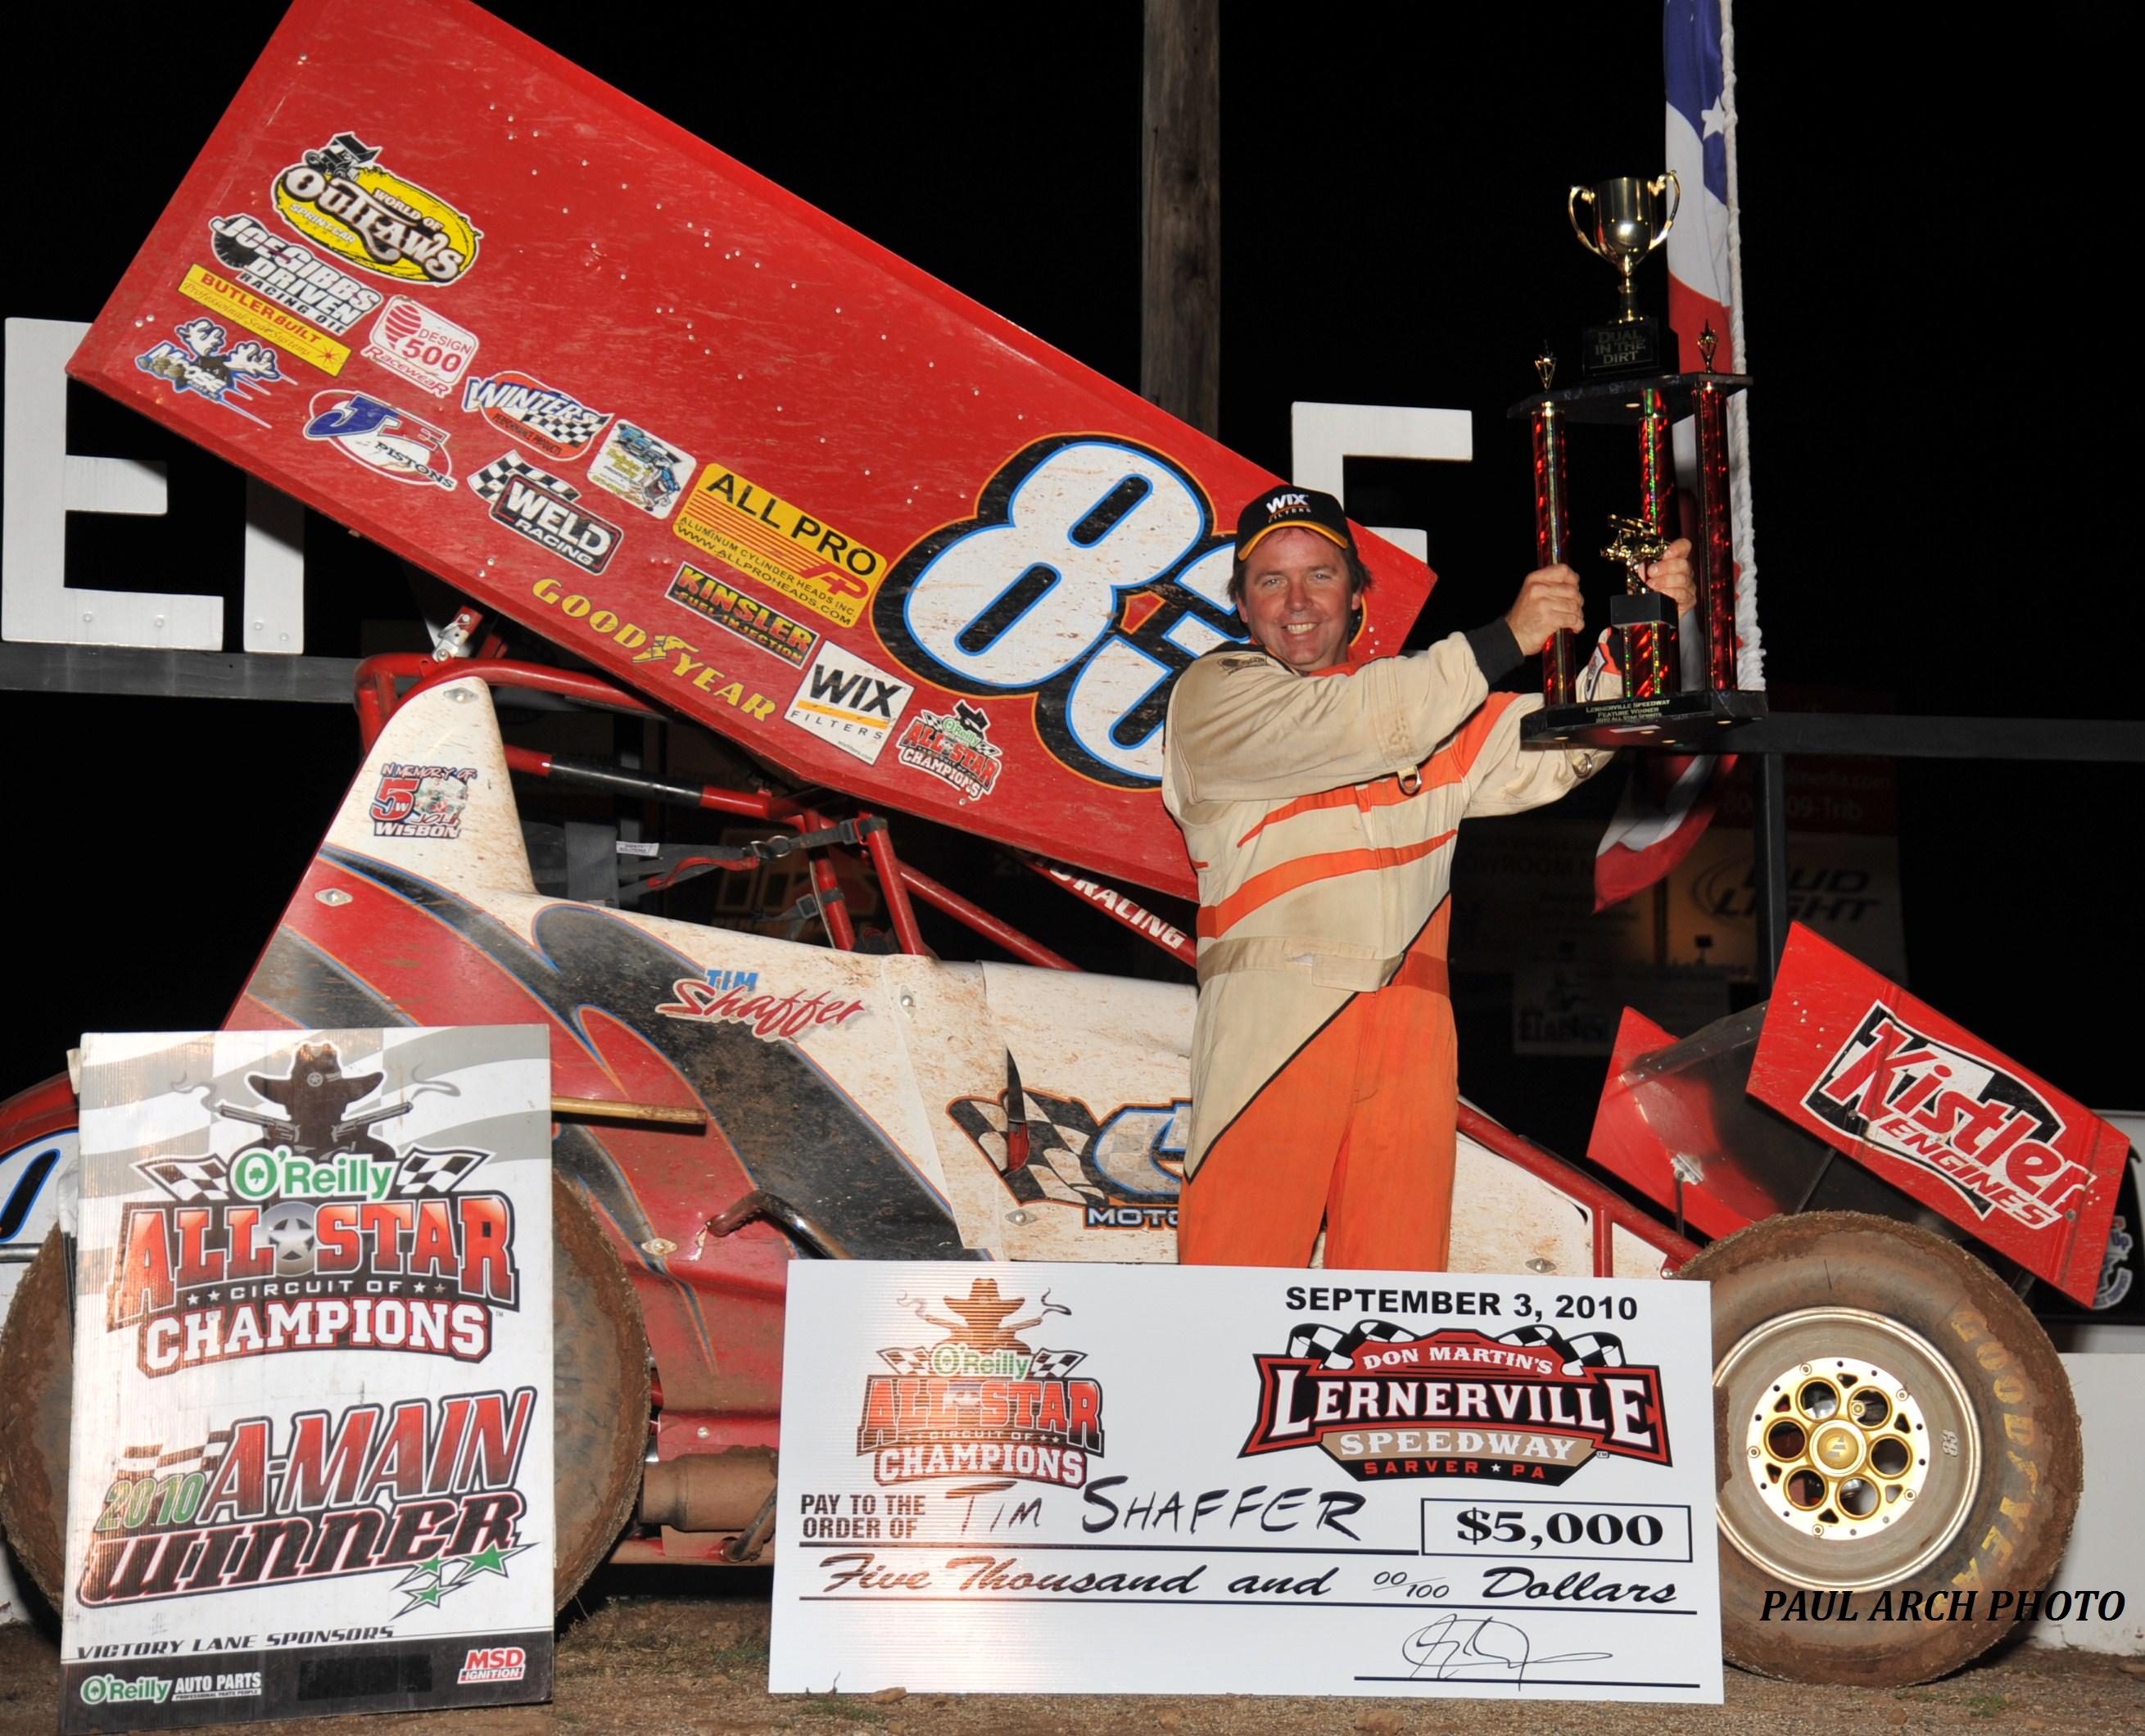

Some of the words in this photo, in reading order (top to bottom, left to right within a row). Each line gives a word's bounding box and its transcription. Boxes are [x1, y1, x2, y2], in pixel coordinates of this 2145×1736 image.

[289, 203, 332, 232] SPRINT
[330, 224, 356, 243] CAR
[372, 188, 423, 219] WORLD
[421, 216, 445, 232] OF
[238, 273, 310, 315] RACING
[247, 256, 364, 327] DRIVEN
[402, 337, 462, 373] 500
[419, 328, 473, 355] DESIGN
[1603, 350, 1639, 365] DIRT
[464, 377, 600, 425] WINTERS
[374, 441, 455, 489] PISTONS
[505, 481, 613, 556] WELD
[706, 472, 781, 530] ALL
[790, 515, 877, 576] PRO
[1266, 494, 1308, 513] WIX
[514, 518, 594, 567] RACING
[677, 526, 851, 626] WWW.ALLPROHEADS.COM
[680, 516, 739, 552] ALUMINUM
[740, 549, 795, 584] CYLINDER
[796, 579, 835, 605] HEADS
[835, 600, 856, 618] INC.
[677, 566, 813, 651] KINSLER
[678, 589, 716, 617] FUEL
[721, 613, 803, 663] INJECTION
[809, 663, 903, 718] WIX
[1632, 698, 1672, 709] SPEEDWAY
[790, 710, 884, 741] FILTERS
[1597, 709, 1629, 719] FEATURE
[1630, 707, 1660, 717] WINNER
[396, 765, 456, 780] MEMORY
[900, 721, 944, 755] ALL
[948, 743, 999, 789] STAR
[902, 748, 982, 798] CHAMPIONS
[1073, 878, 1188, 950] RACING
[706, 969, 759, 993] TIM
[658, 979, 865, 1040] Shaffer
[1821, 1018, 2097, 1206] Kistler
[235, 1149, 392, 1198] O'Reilly
[1878, 1113, 2063, 1229] ENGINES
[112, 1201, 278, 1322] ALL
[313, 1194, 518, 1304] STAR
[230, 1280, 354, 1300] CIRCUIT
[366, 1280, 403, 1295] OF
[1285, 1286, 1501, 1316] SEPTEMBER
[1514, 1293, 1543, 1322] 3,
[1555, 1294, 1638, 1320] 2010
[145, 1298, 486, 1373] CHAMPIONS
[931, 1344, 1030, 1381] O'Reilly
[1363, 1347, 1419, 1371] DON
[1429, 1346, 1554, 1376] MARTIN'S
[858, 1378, 950, 1453] ALL
[980, 1378, 1102, 1454] STAR
[1270, 1368, 1652, 1447] LERNERVILLE
[197, 1390, 534, 1524] A-MAIN
[929, 1429, 1005, 1441] CIRCUIT
[1011, 1431, 1033, 1441] OF
[1339, 1431, 1577, 1461] SPEEDWAY
[877, 1444, 1084, 1487] CHAMPIONS
[1364, 1460, 1479, 1476] SARVER
[1513, 1463, 1545, 1479] PA
[96, 1472, 207, 1532] 2010
[800, 1494, 842, 1517] PAY
[849, 1494, 876, 1517] TO
[885, 1494, 925, 1517] THE
[945, 1481, 1043, 1536] TIM
[1082, 1476, 1366, 1541] SHAFFER
[803, 1517, 881, 1539] ORDER
[889, 1517, 919, 1539] OF
[1456, 1506, 1663, 1550] $5,000
[819, 1553, 934, 1594] Five
[945, 1556, 1208, 1594] Thousand
[1228, 1566, 1341, 1596] and
[1482, 1566, 1678, 1604] Dollars
[77, 1639, 185, 1660] VICTORY
[192, 1634, 256, 1652] LANE
[265, 1625, 395, 1648] SPONSORS
[464, 1648, 526, 1669] MSD
[81, 1675, 170, 1704] O'Reilly
[174, 1675, 213, 1693] AUTO
[216, 1671, 262, 1691] PARTS
[462, 1666, 524, 1681] IGNITION
